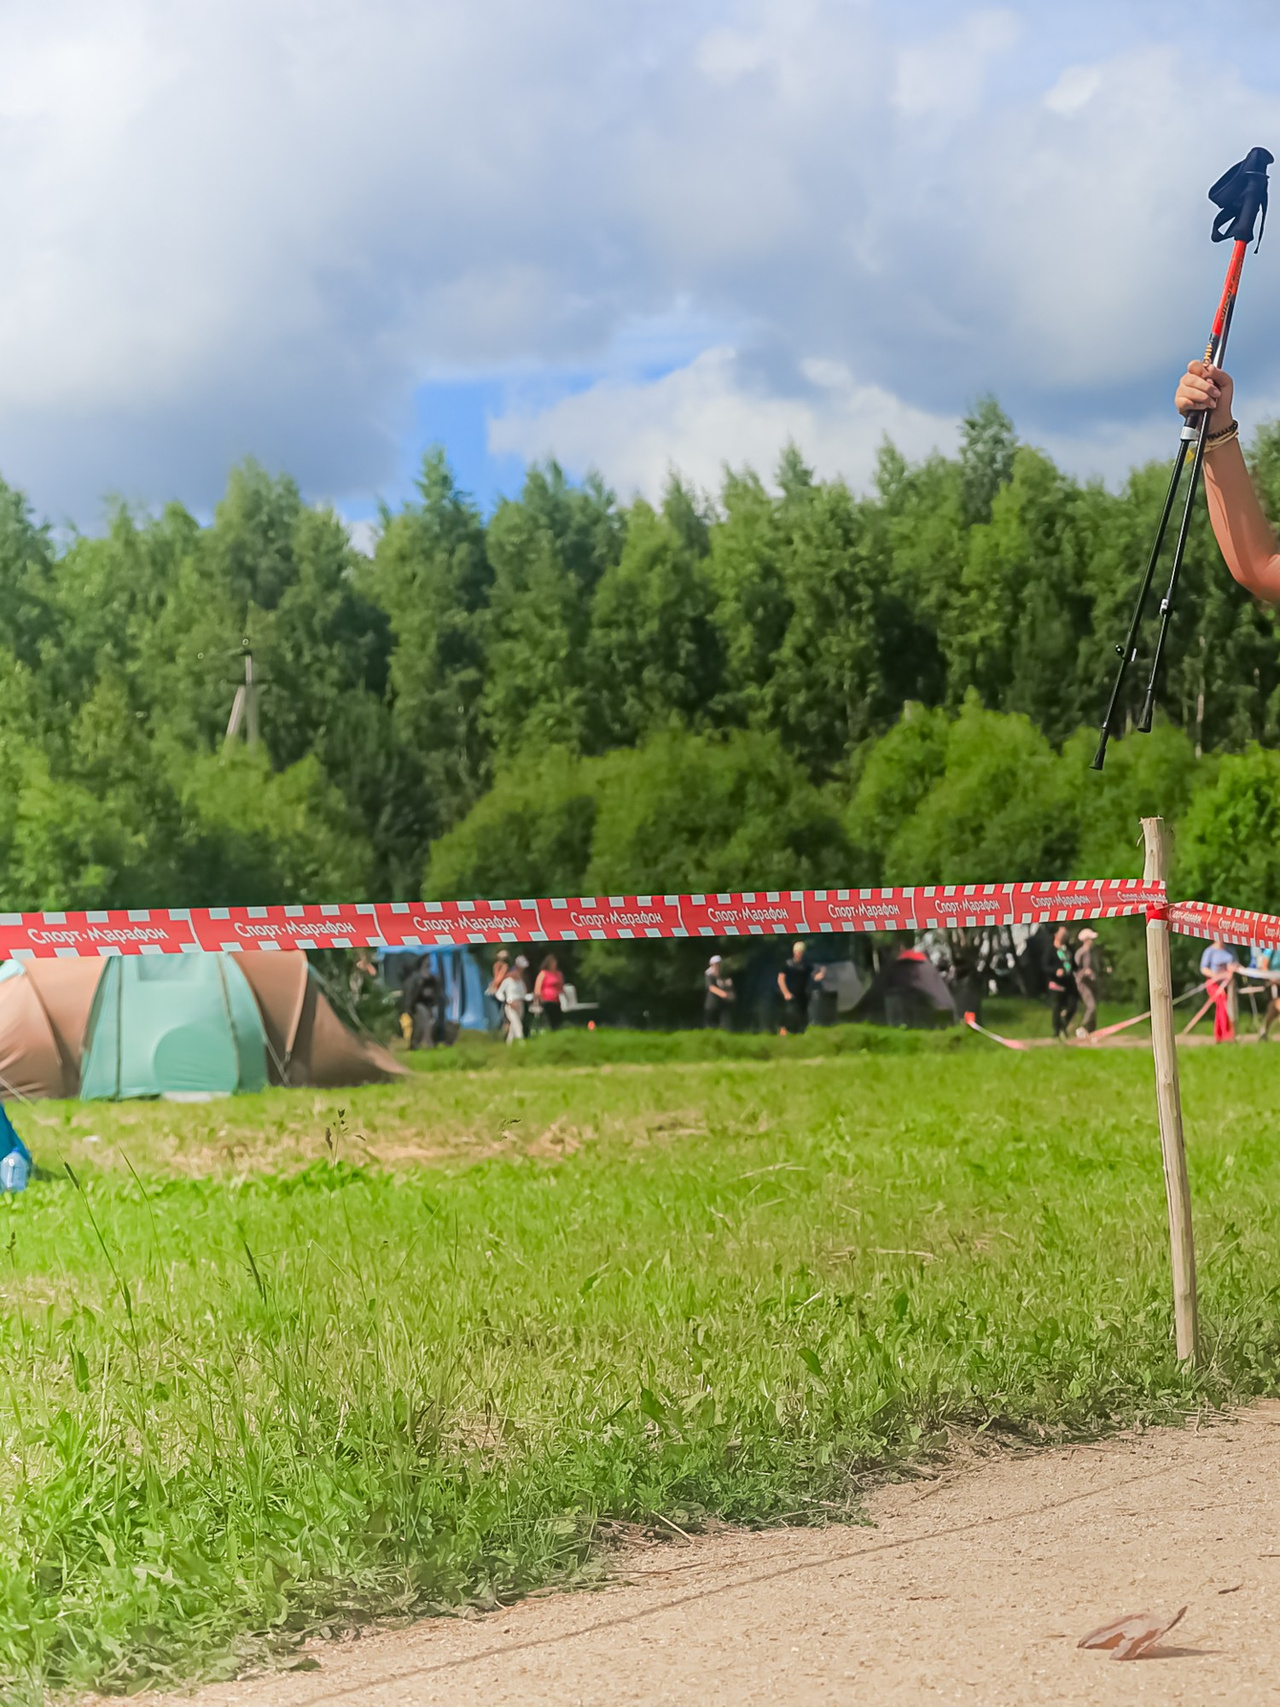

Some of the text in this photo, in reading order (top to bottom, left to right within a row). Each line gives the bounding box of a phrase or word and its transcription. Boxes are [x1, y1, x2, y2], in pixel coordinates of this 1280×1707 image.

[707, 905, 790, 925] Спорт·Марафон
[828, 902, 901, 921] Спорт·Марафон
[935, 897, 1001, 917] Спорт·Марафон
[234, 920, 357, 939] Спорт·Марафон
[413, 914, 522, 935] Спорт·Марафон
[570, 910, 664, 929] Спорт·Марафон
[27, 926, 169, 946] Спорт·Марафон
